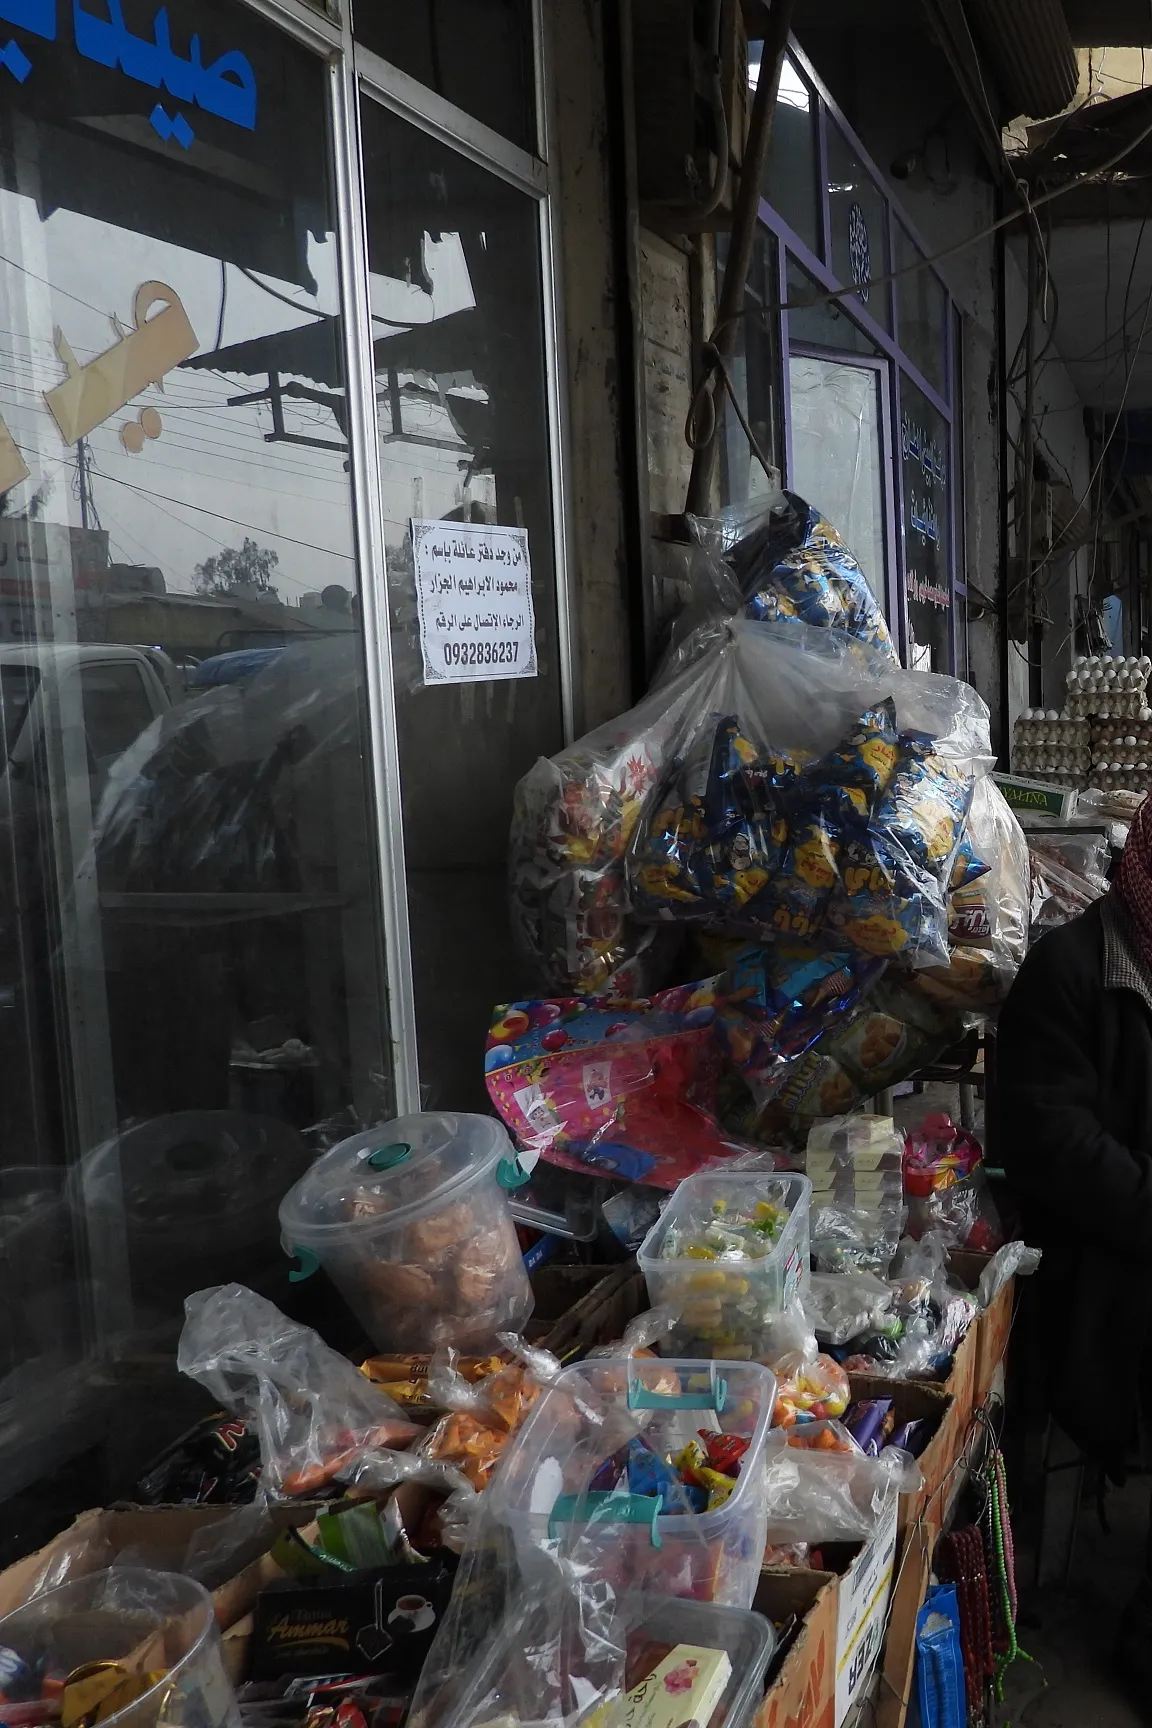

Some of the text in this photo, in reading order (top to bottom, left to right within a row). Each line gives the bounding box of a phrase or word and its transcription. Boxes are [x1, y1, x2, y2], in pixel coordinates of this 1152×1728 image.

[452, 539, 476, 562] عائلة
[477, 543, 494, 563] دفتر
[495, 548, 512, 565] وجد
[513, 548, 522, 567] من
[429, 573, 518, 597] محمود الابراهيم الجزار
[435, 611, 457, 632] الرقم
[458, 614, 472, 632] على
[503, 613, 524, 631] الرجاء
[443, 641, 519, 666] 0932836237
[266, 1613, 349, 1642] Ammar
